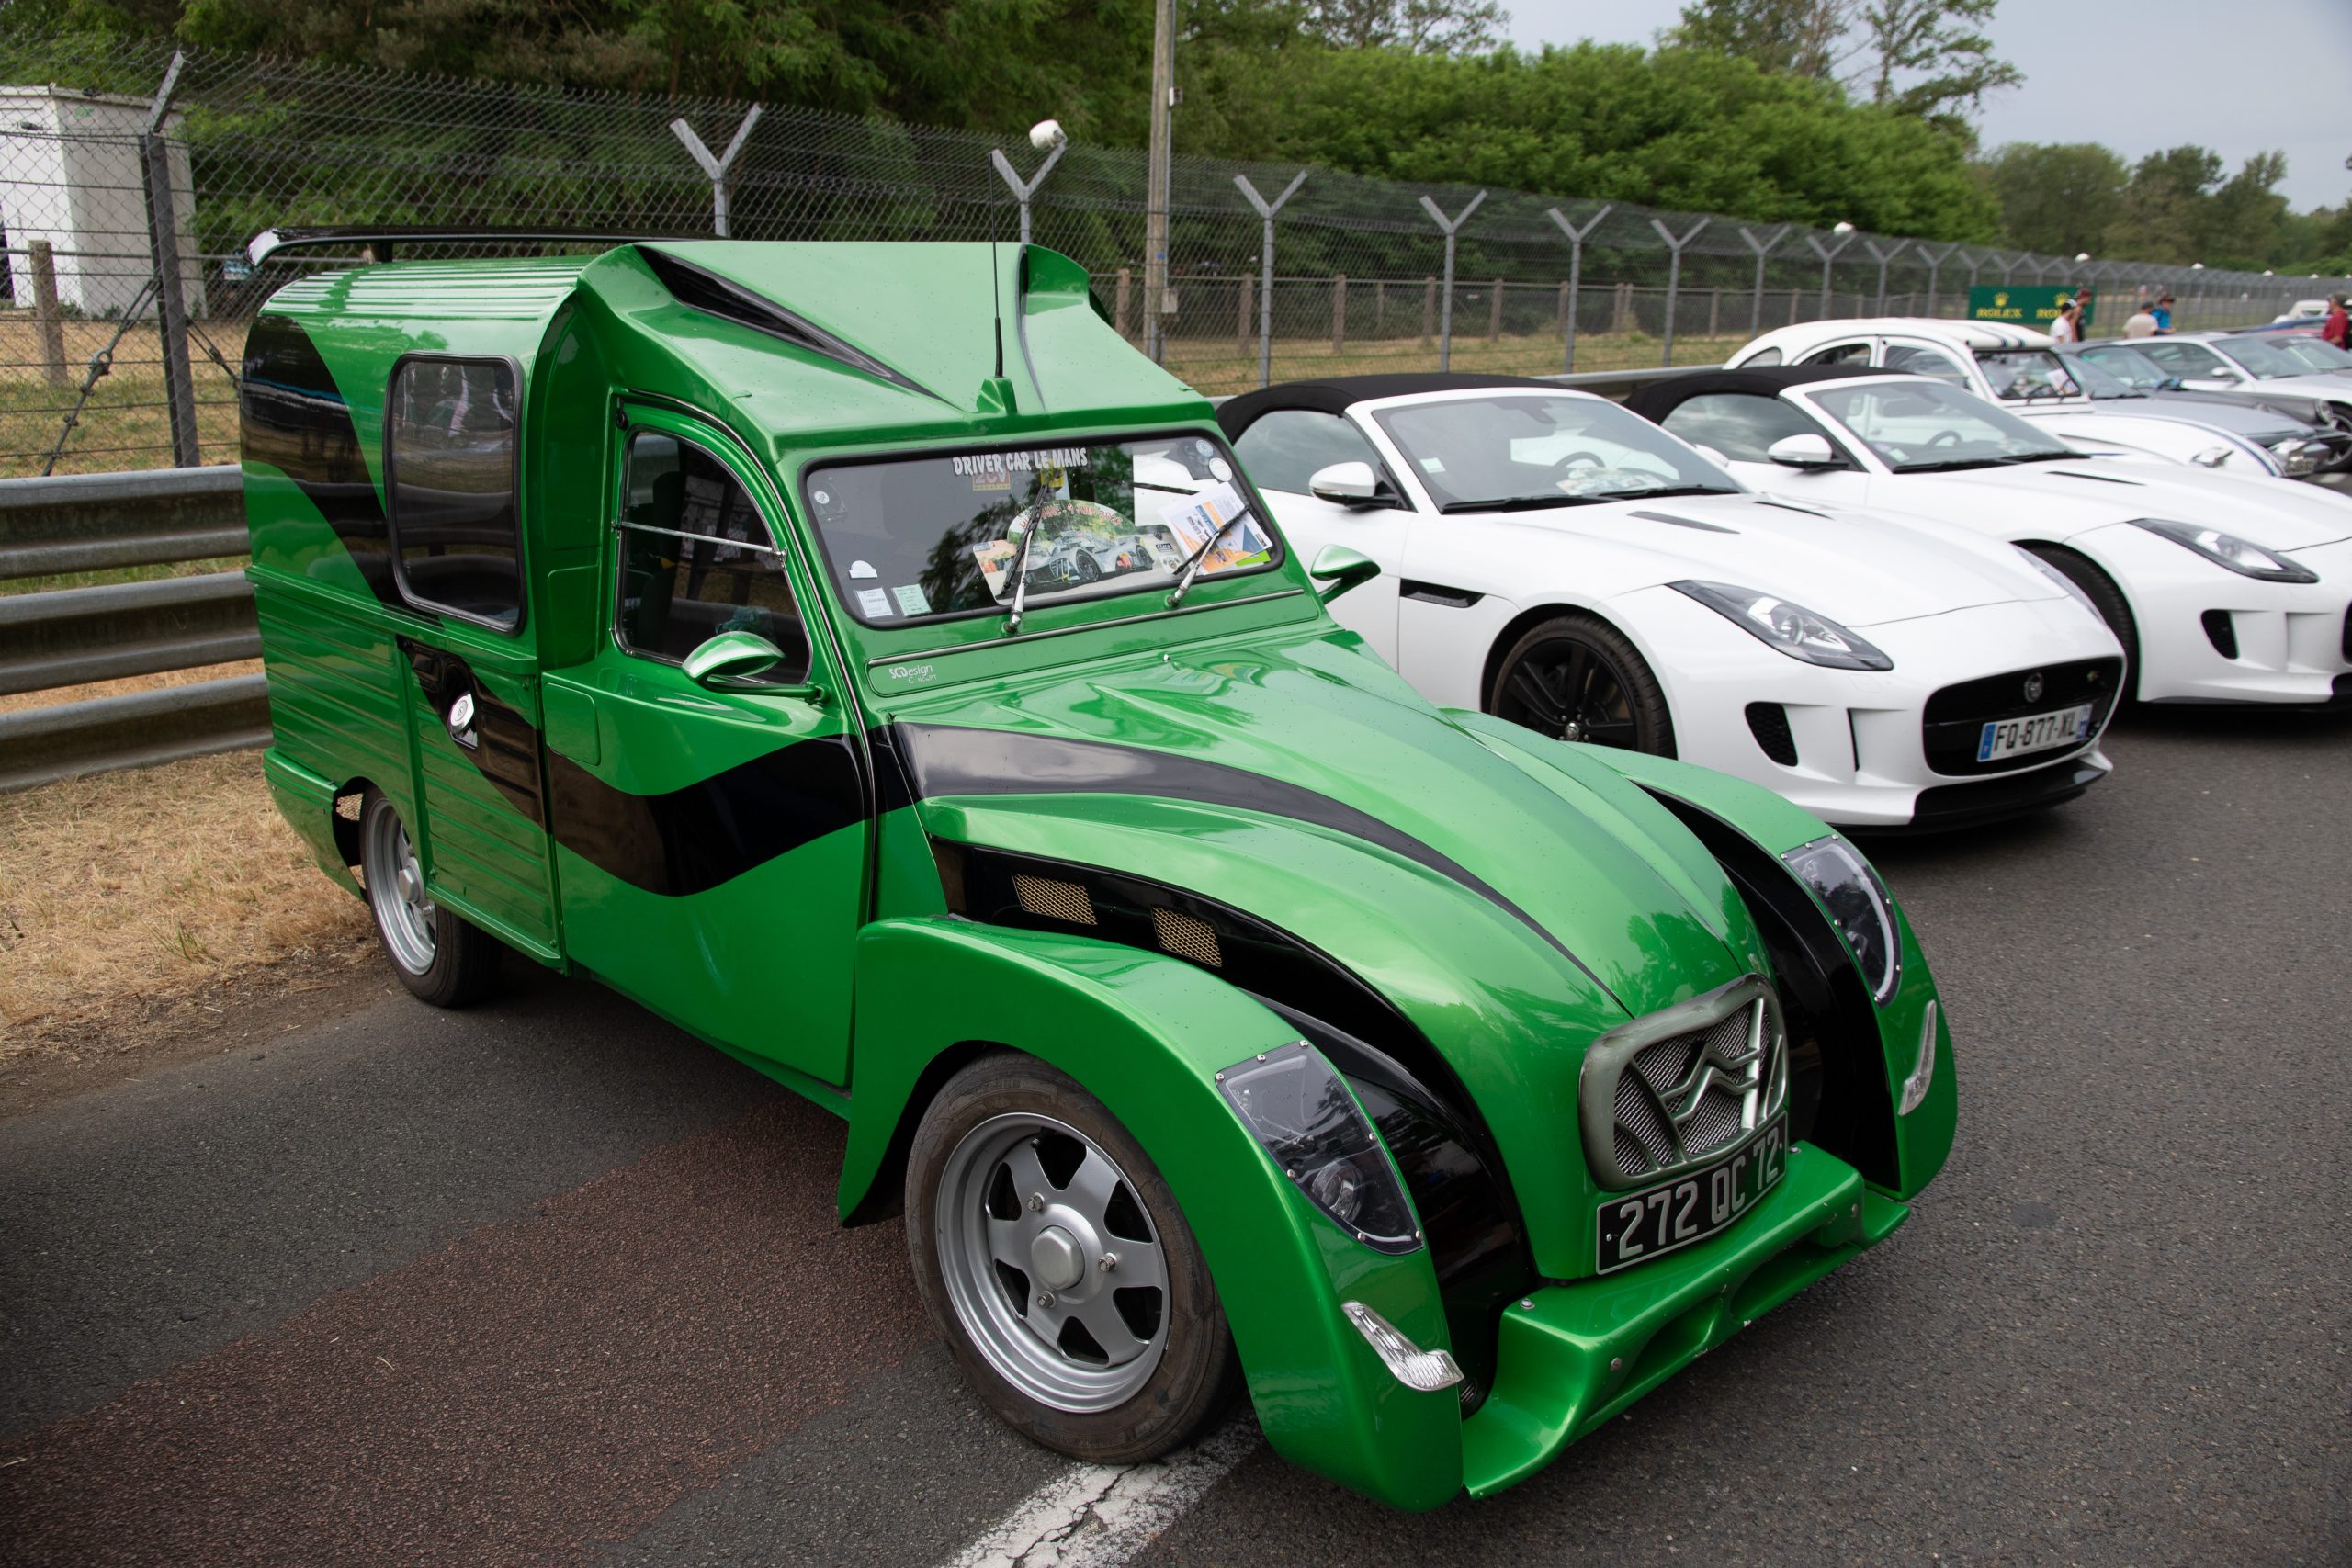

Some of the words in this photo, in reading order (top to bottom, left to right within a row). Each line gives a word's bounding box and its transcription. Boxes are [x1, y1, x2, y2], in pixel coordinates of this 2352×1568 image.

[1976, 308, 2022, 319] ROLEX
[953, 453, 1004, 476] DRIVER
[1005, 451, 1032, 471] CAR
[1034, 450, 1050, 469] LE
[1052, 447, 1088, 468] MANS
[1993, 711, 2076, 751] FQ-877-XL
[1618, 1179, 1699, 1260] 272
[1711, 1155, 1747, 1224] QC
[1752, 1126, 1780, 1192] 72
